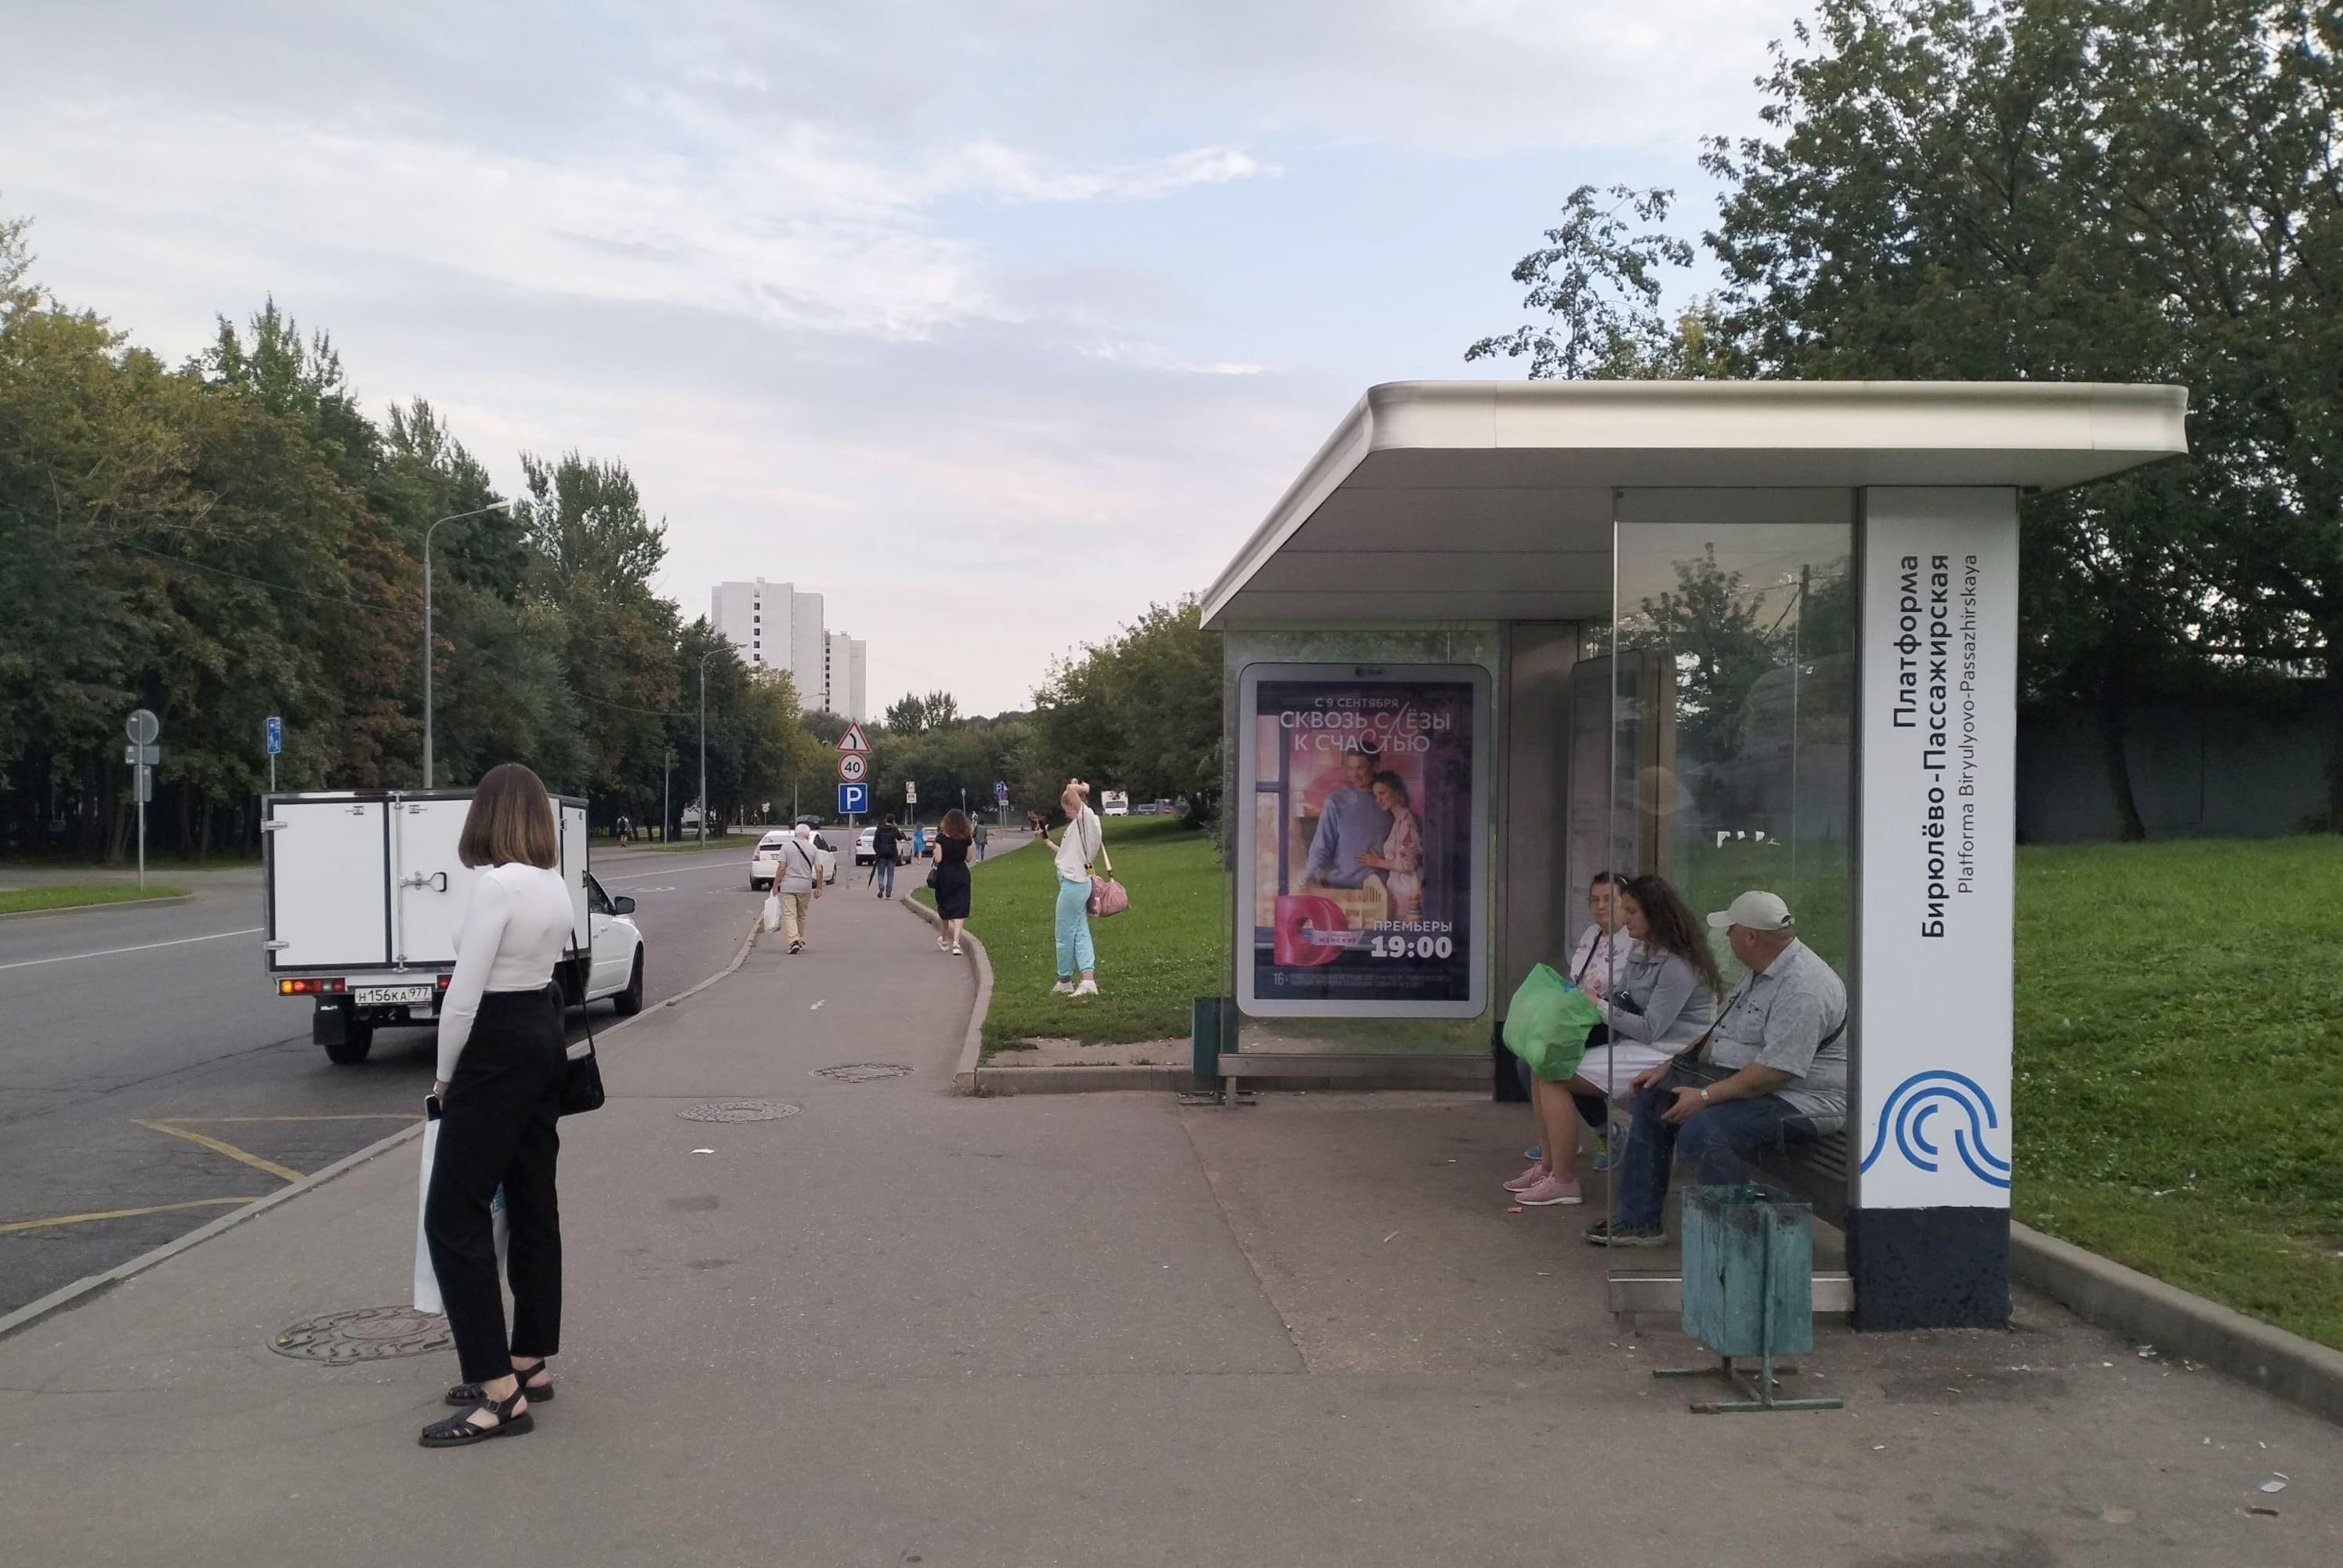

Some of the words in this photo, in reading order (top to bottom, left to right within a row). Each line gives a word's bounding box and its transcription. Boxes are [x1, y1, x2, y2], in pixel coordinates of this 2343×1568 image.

[1893, 556, 1921, 727] Платформа
[1958, 555, 1980, 796] Biryulyovo-Passazhirskaya
[1315, 698, 1323, 707] С
[1337, 698, 1399, 708] СЕНТЯБРЯ
[1280, 710, 1368, 728] СКВОЗЬ
[1295, 734, 1309, 751] К
[1315, 729, 1431, 754] СЧАСТЬЮ
[1921, 555, 1952, 938] Бирюлёво-Пассажирская
[845, 762, 860, 773] 40
[847, 787, 862, 809] P
[1957, 803, 1974, 893] Platforma
[1373, 920, 1453, 932] ПРЕМЬЕРЫ
[1371, 935, 1453, 958] 19:00
[409, 987, 428, 998] 977
